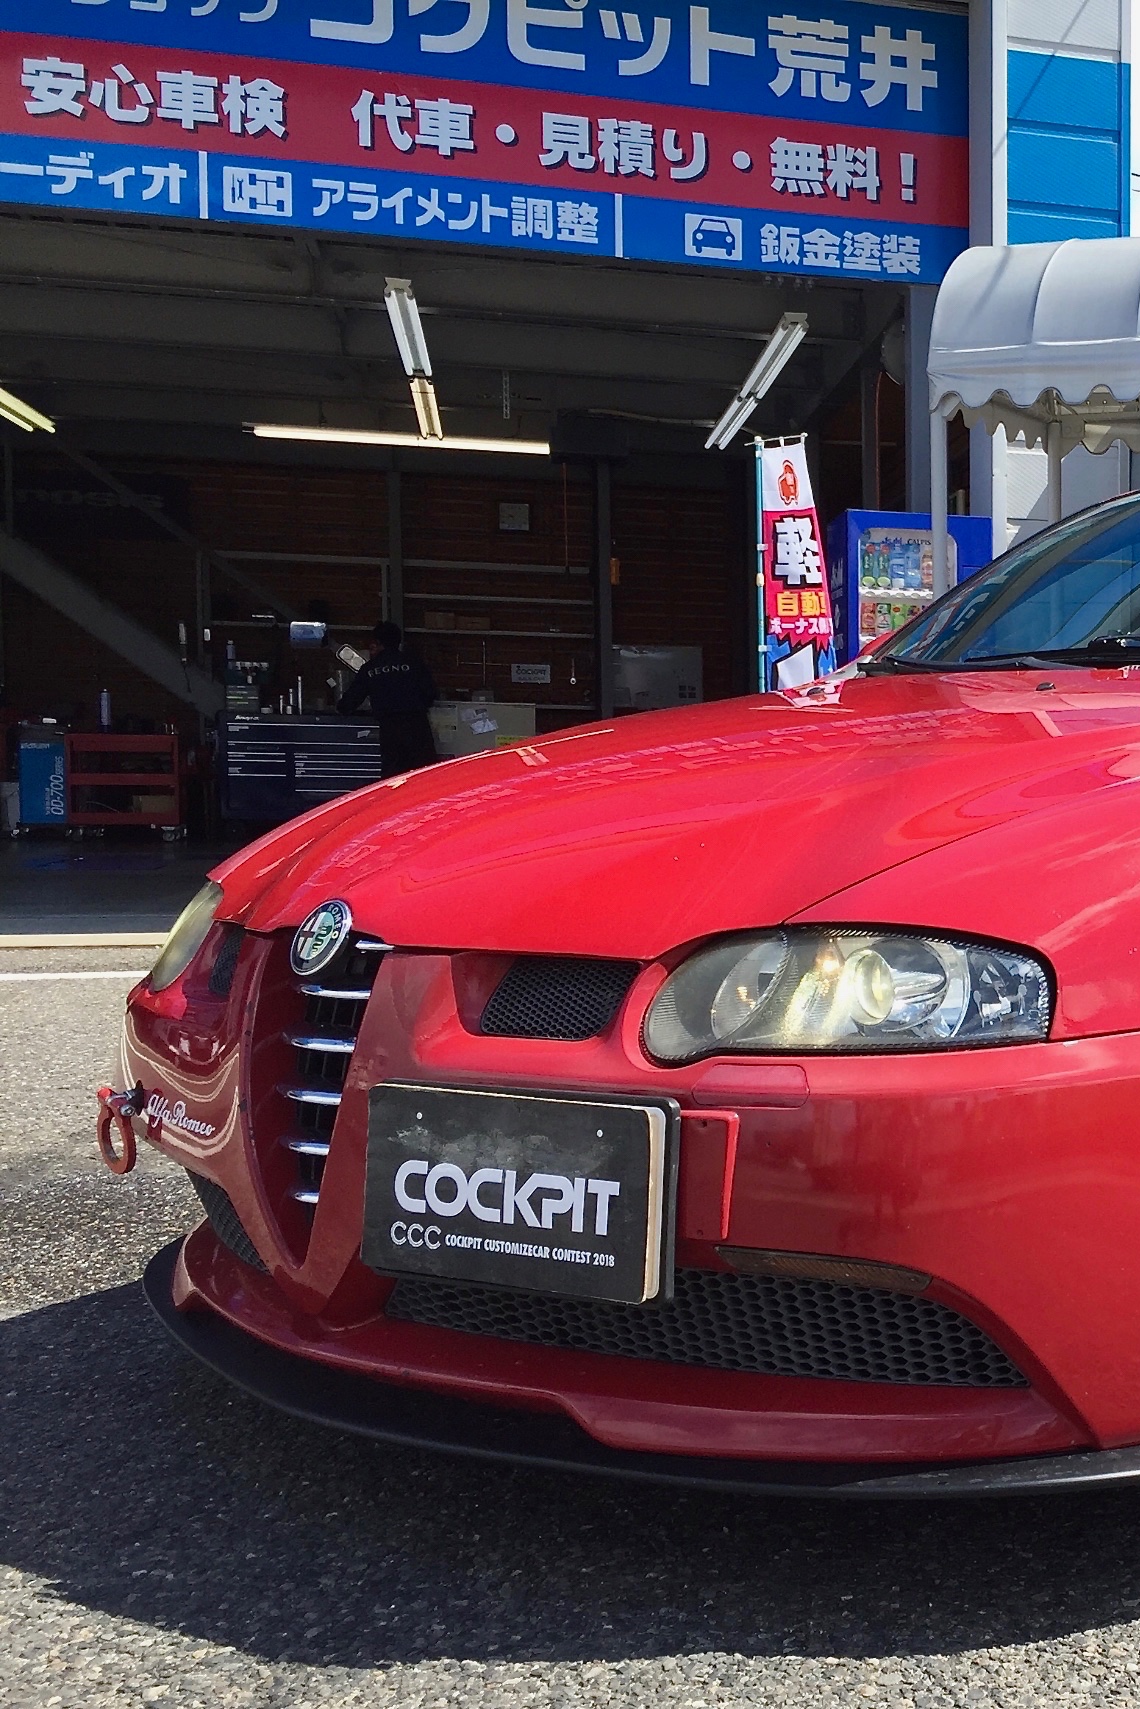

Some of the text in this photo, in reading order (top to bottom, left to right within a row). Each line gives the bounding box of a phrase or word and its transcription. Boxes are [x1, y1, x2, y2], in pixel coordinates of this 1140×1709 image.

[21, 57, 287, 138] 安心車検
[312, 178, 599, 245] アライメント調整
[760, 223, 921, 275] 鈑金塗装
[775, 517, 823, 585] 軽
[147, 1093, 216, 1137] Alfa Romeo
[394, 1160, 620, 1236] COCKPIT
[390, 1221, 615, 1267] CCC COCKPIT CUSTOMIZECAR CONTEST 2018
